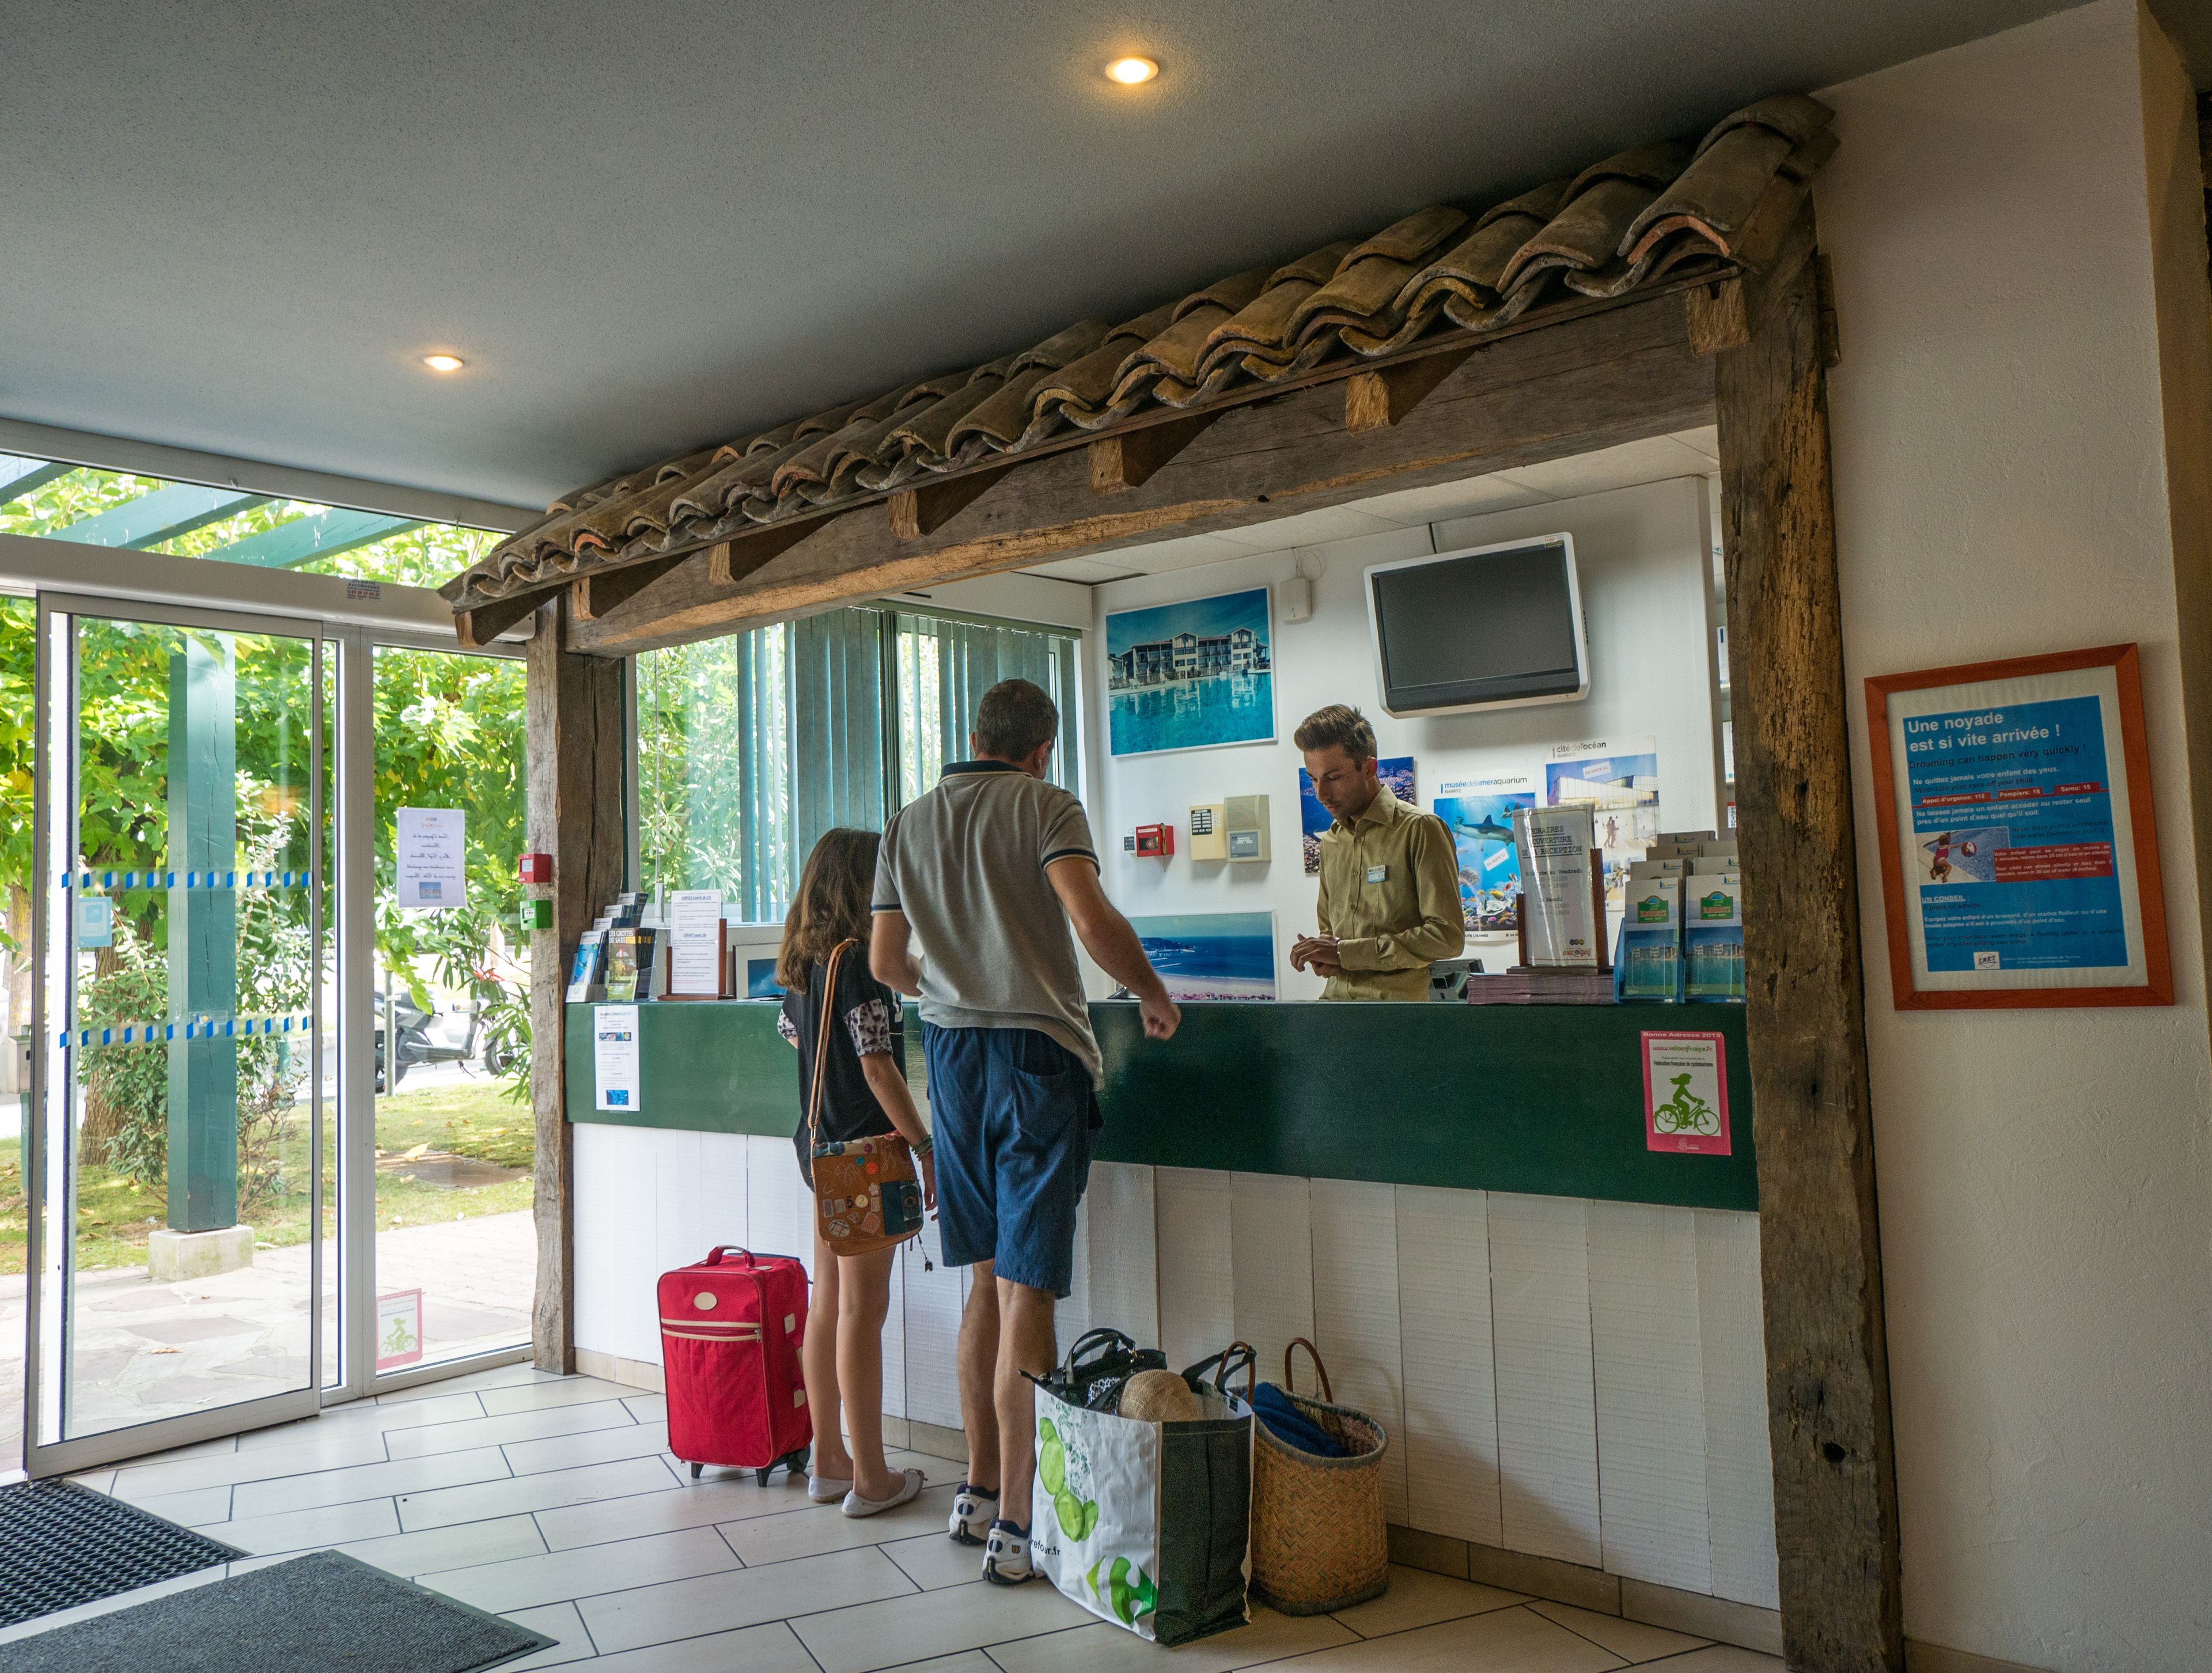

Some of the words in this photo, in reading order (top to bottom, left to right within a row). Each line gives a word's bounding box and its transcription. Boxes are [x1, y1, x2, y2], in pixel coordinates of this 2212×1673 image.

[1908, 718, 1938, 733] Une
[1944, 710, 2003, 732] noyade
[1910, 740, 1934, 752] est
[1938, 736, 1952, 750] si
[1957, 732, 1987, 747] vite
[1991, 724, 2049, 744] arrivée
[2055, 724, 2061, 736] !
[1908, 757, 1955, 771] Drowning
[1978, 751, 2014, 764] happen
[2018, 750, 2039, 760] very
[2042, 744, 2080, 758] quickly
[1924, 776, 1949, 785] quittez
[1949, 774, 1974, 782] jamais
[1997, 769, 2020, 777] enfant
[2038, 766, 2059, 775] yeux.
[1941, 794, 1972, 804] d'urgence:
[1999, 789, 2031, 798] Pompiers:
[1951, 807, 1974, 815] jamais
[1531, 826, 1564, 835] HORAIRES
[1541, 846, 1582, 855] RECEPTION
